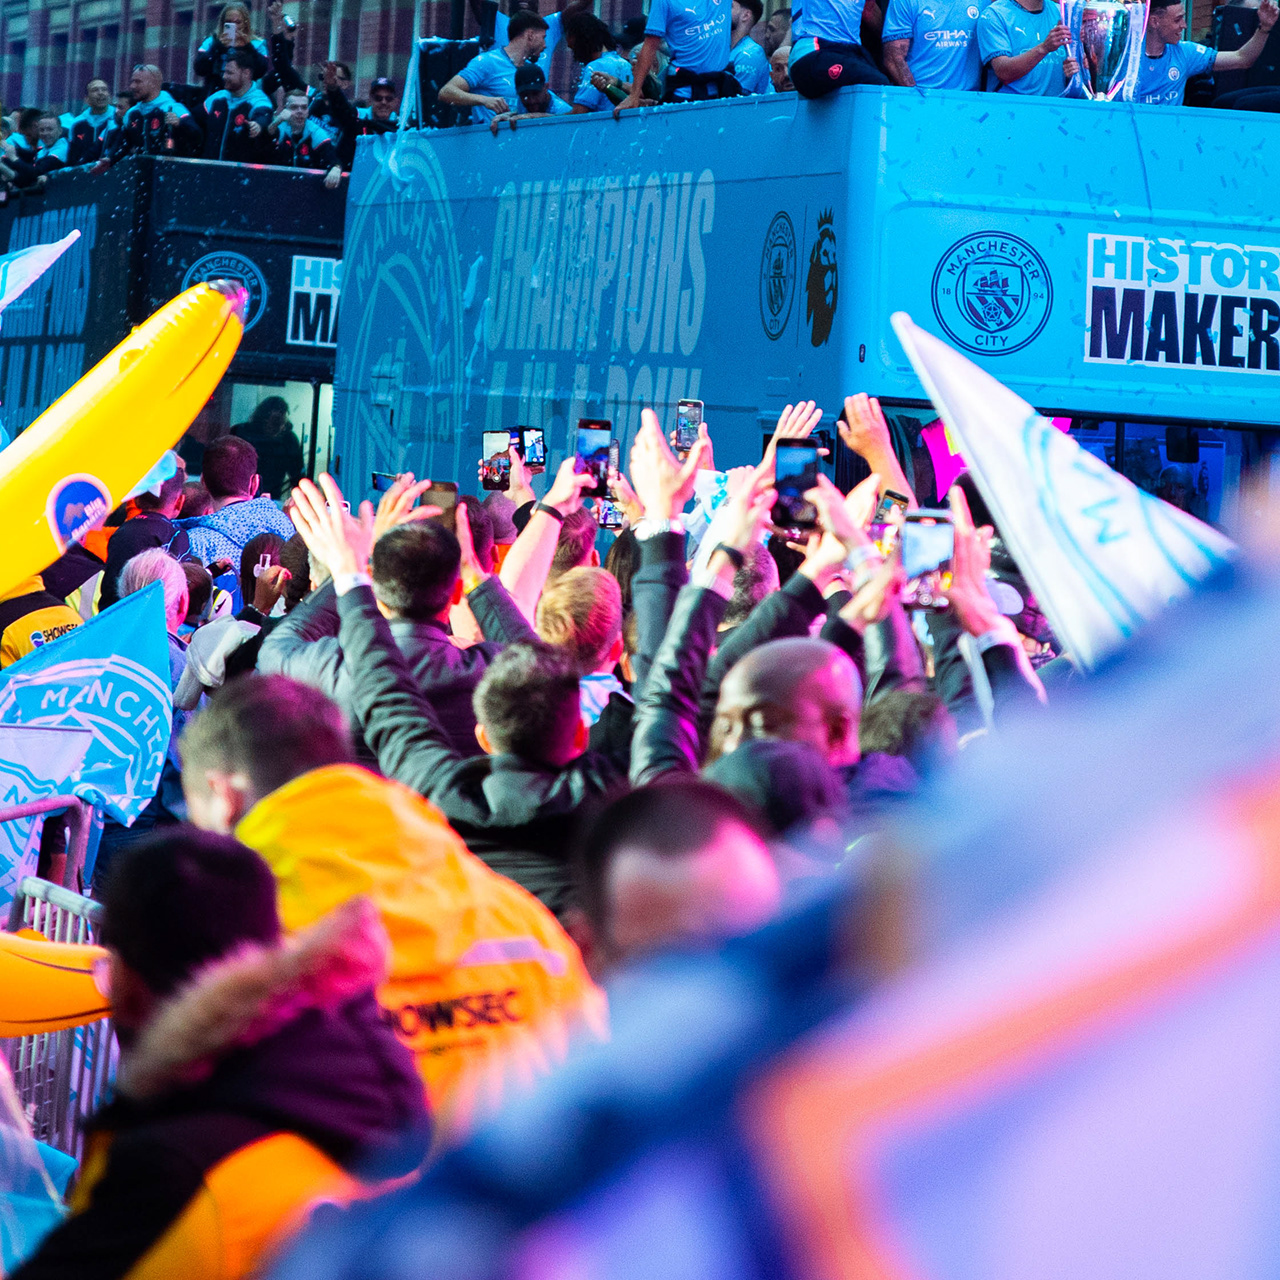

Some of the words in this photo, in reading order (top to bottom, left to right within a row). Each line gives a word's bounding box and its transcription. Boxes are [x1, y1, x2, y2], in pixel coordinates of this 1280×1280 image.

[192, 258, 259, 287] MANCHESTER
[486, 168, 716, 357] CHAMPIONS
[946, 240, 1040, 281] MANCHESTER
[942, 286, 952, 296] 18
[974, 333, 1010, 348] CITY
